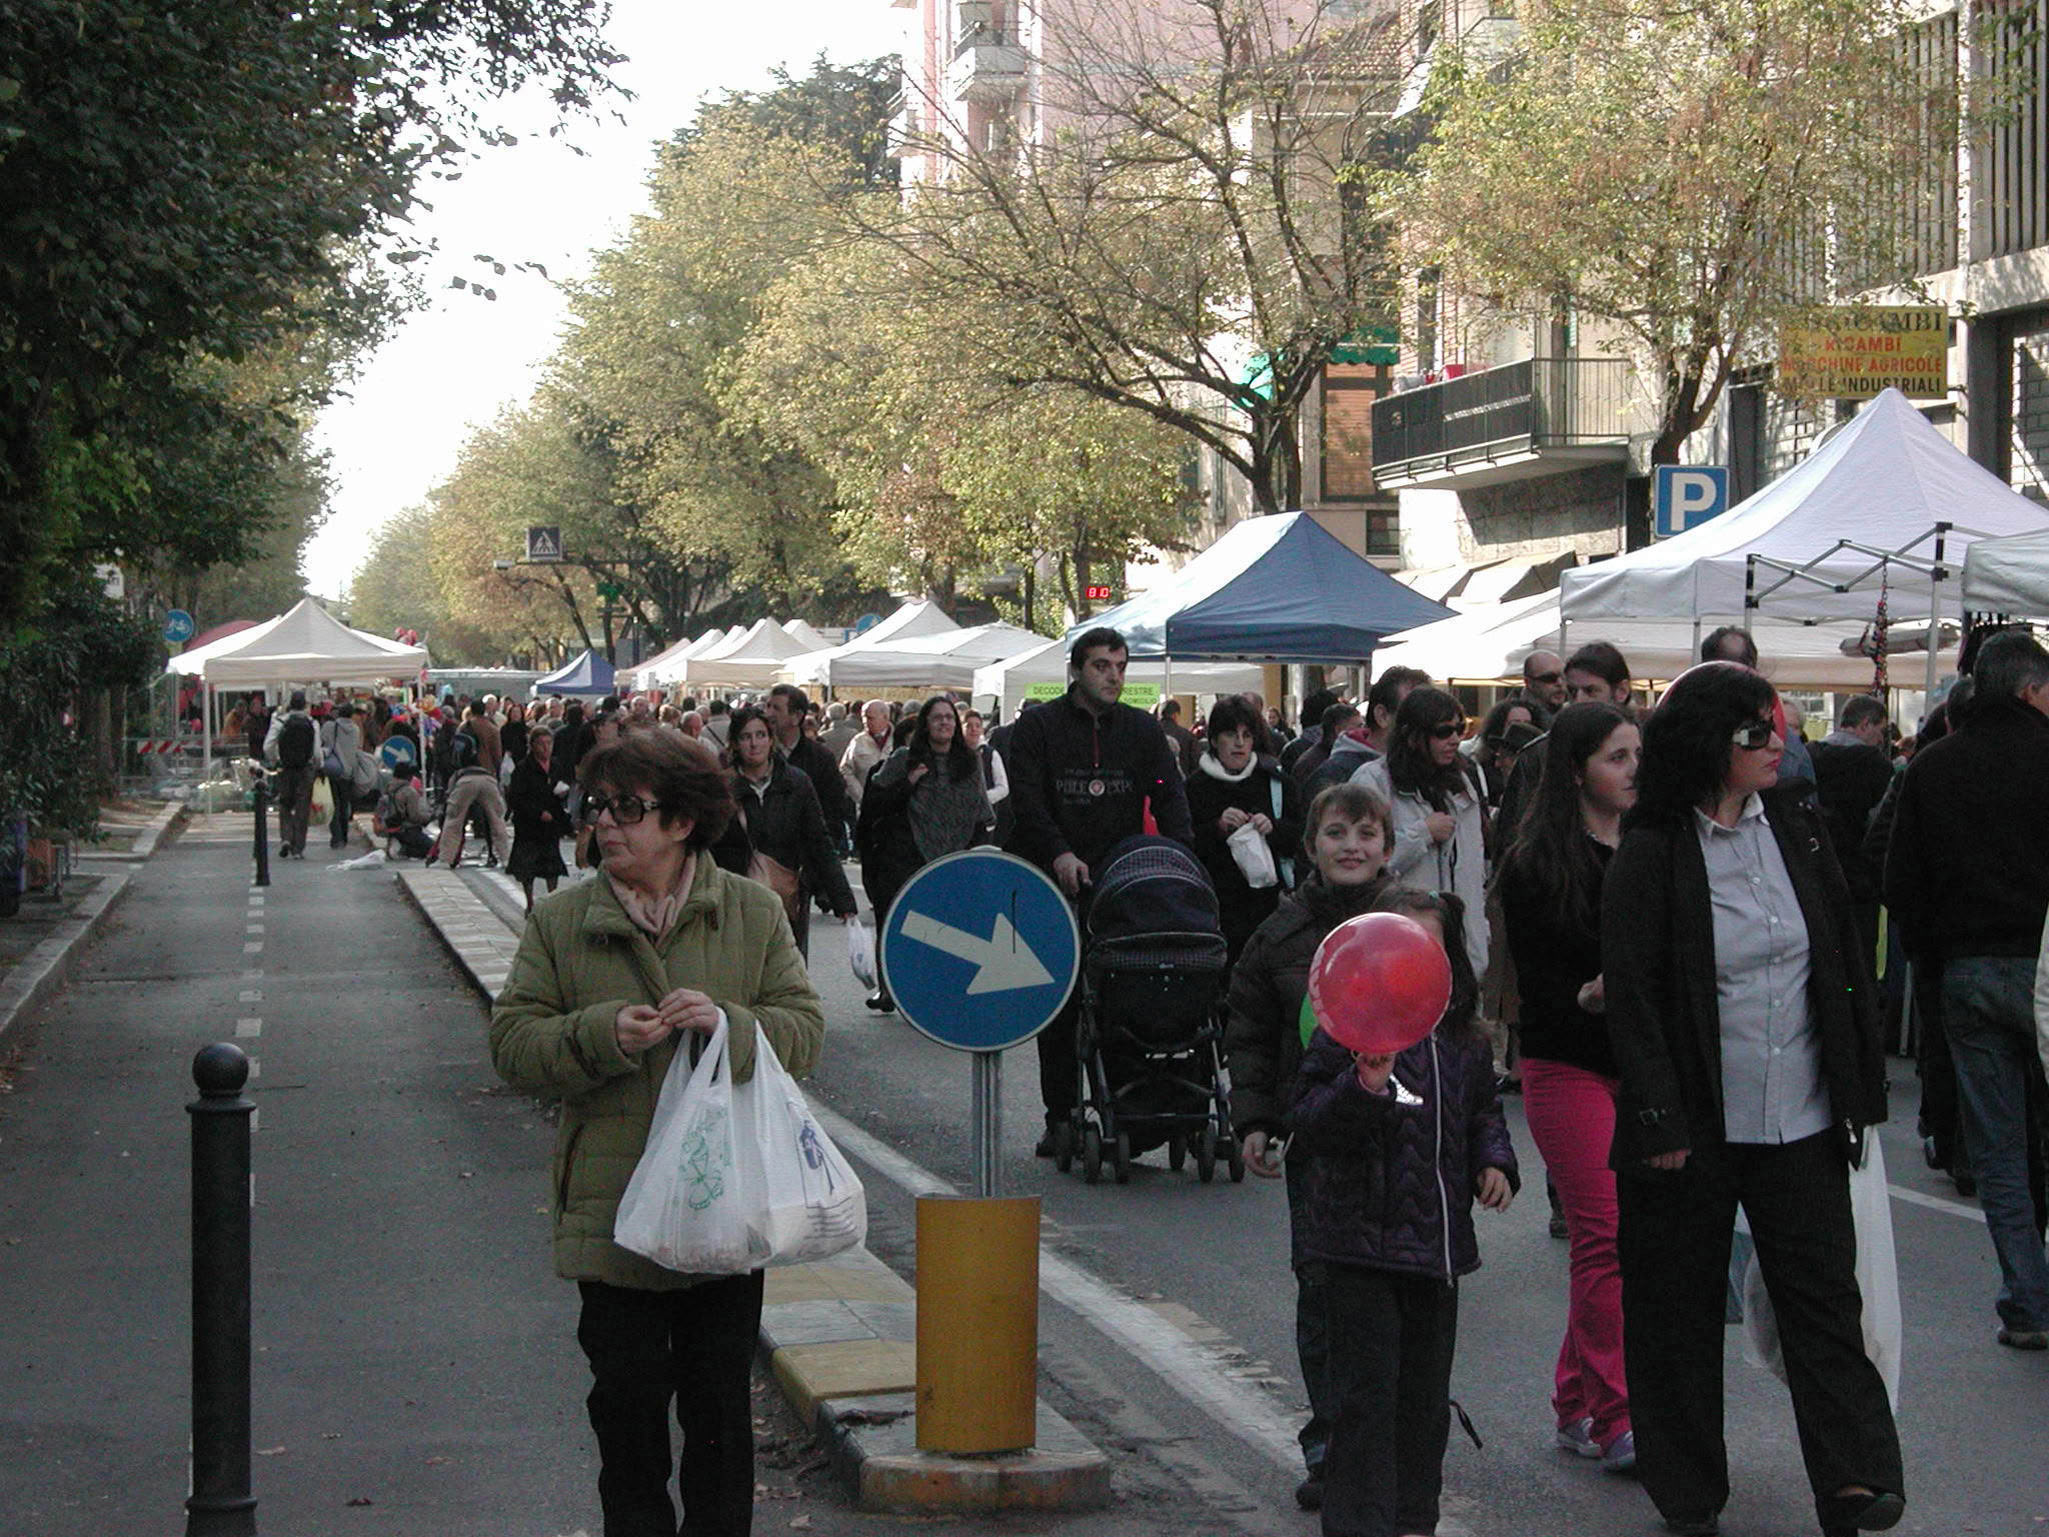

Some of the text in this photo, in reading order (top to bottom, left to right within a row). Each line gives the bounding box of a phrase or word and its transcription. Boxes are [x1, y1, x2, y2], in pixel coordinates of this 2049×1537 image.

[1825, 336, 1902, 352] RICAMBI
[1781, 356, 1942, 373] MCCHINE AGRICOLE
[1843, 377, 1941, 393] INDUSTRIALI
[1671, 472, 1717, 531] P
